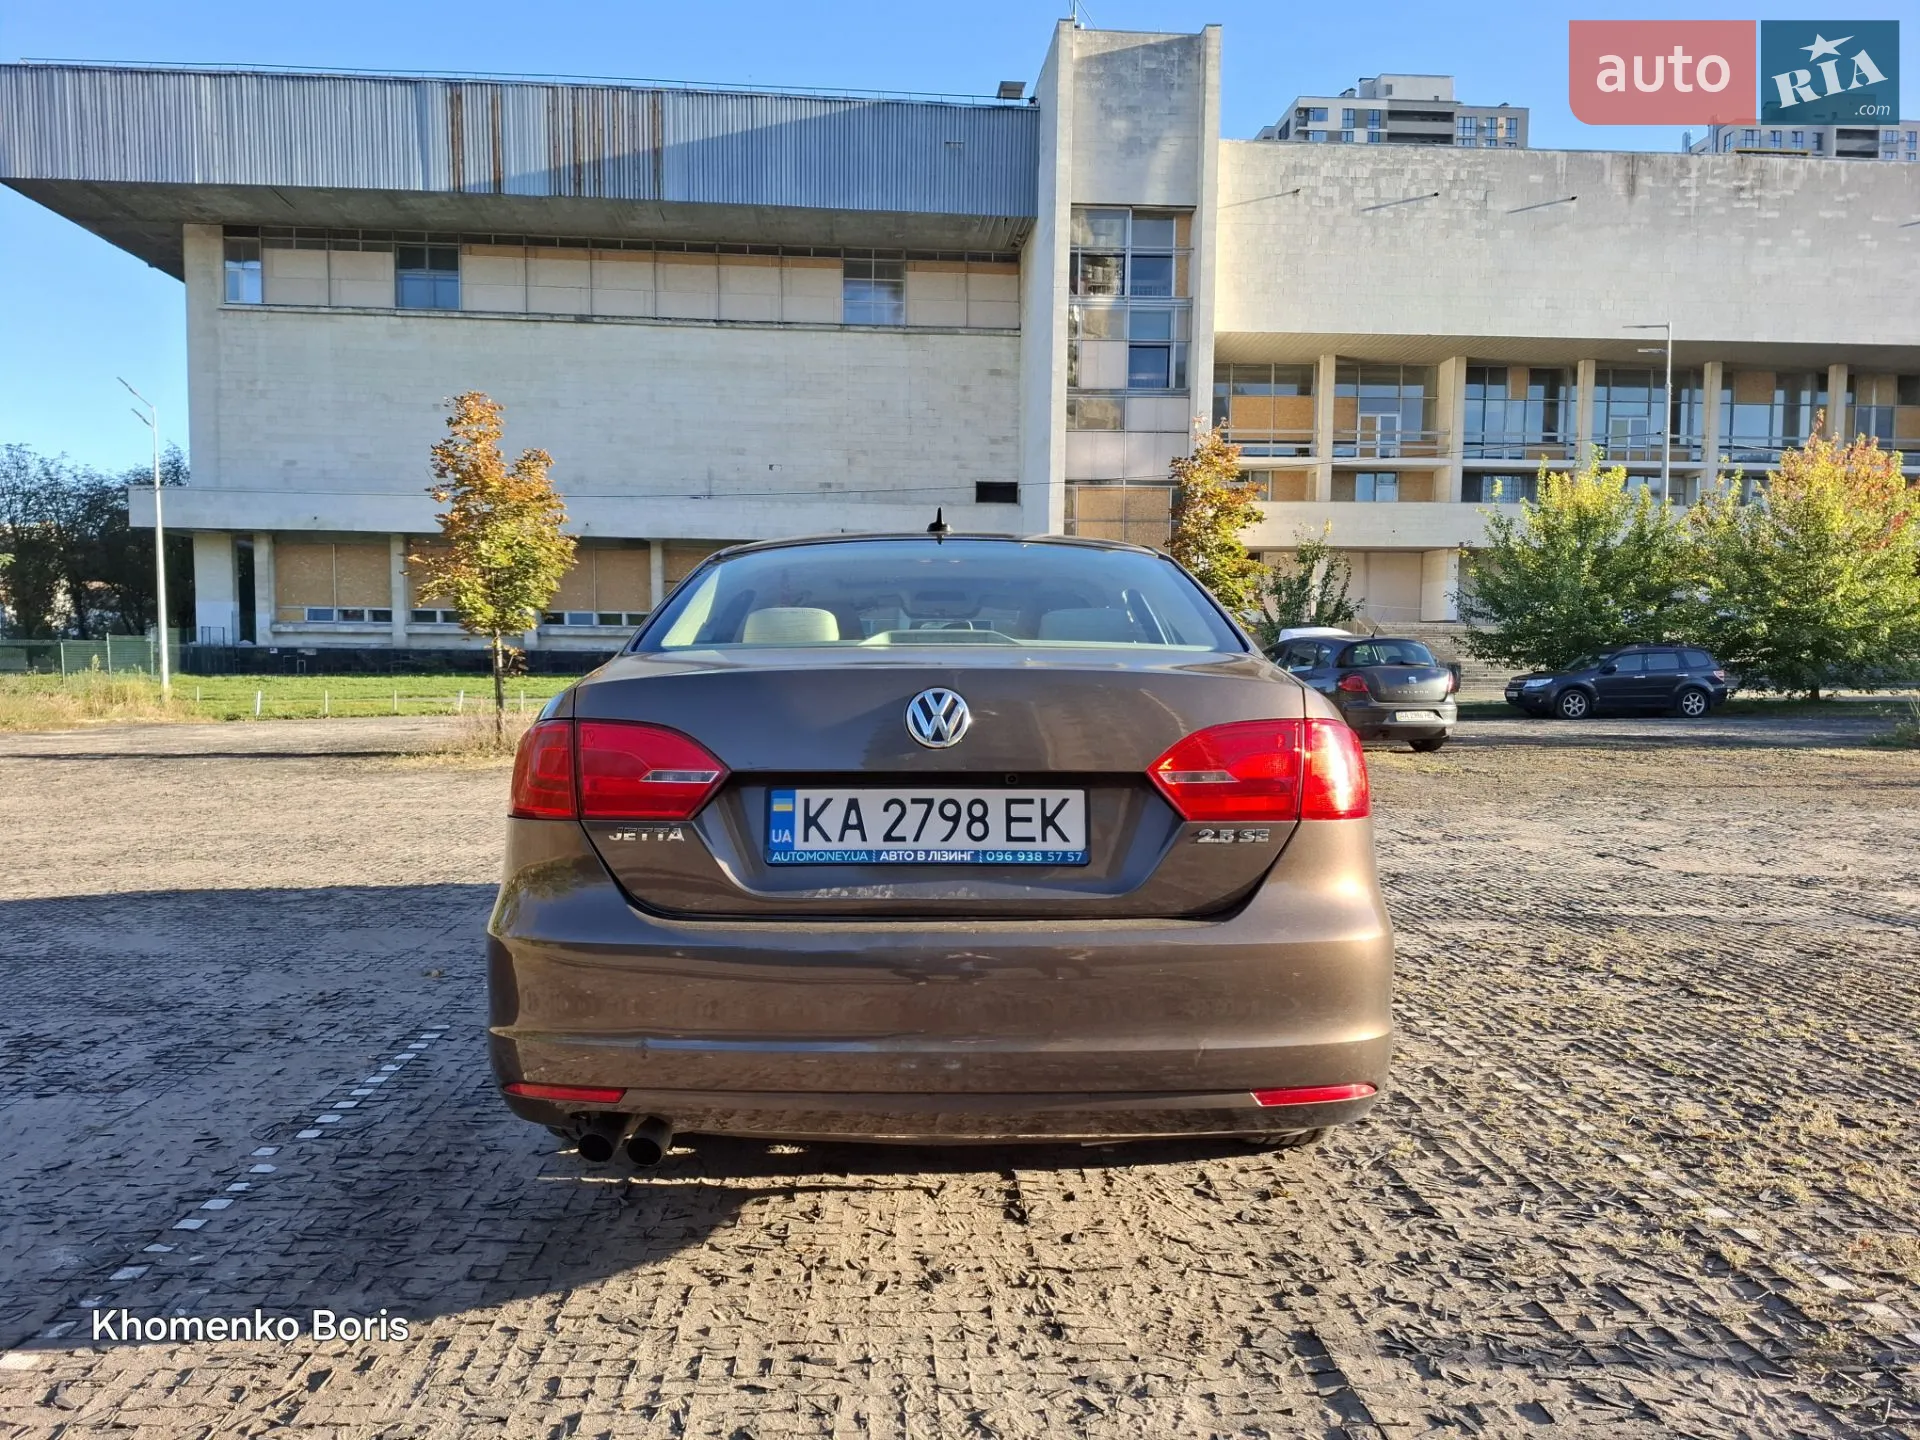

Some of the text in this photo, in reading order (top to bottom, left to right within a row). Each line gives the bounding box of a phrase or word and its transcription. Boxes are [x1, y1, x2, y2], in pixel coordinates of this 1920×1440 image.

[803, 797, 1071, 843] KA 2798 EK
[608, 827, 685, 842] JETTA
[771, 829, 792, 843] UA
[1239, 828, 1270, 843] SE
[772, 851, 868, 862] AUTOMONEY.UA
[880, 850, 974, 861] АВТО В ЛІЗИНГ
[986, 851, 1082, 862] 096 938 57 57
